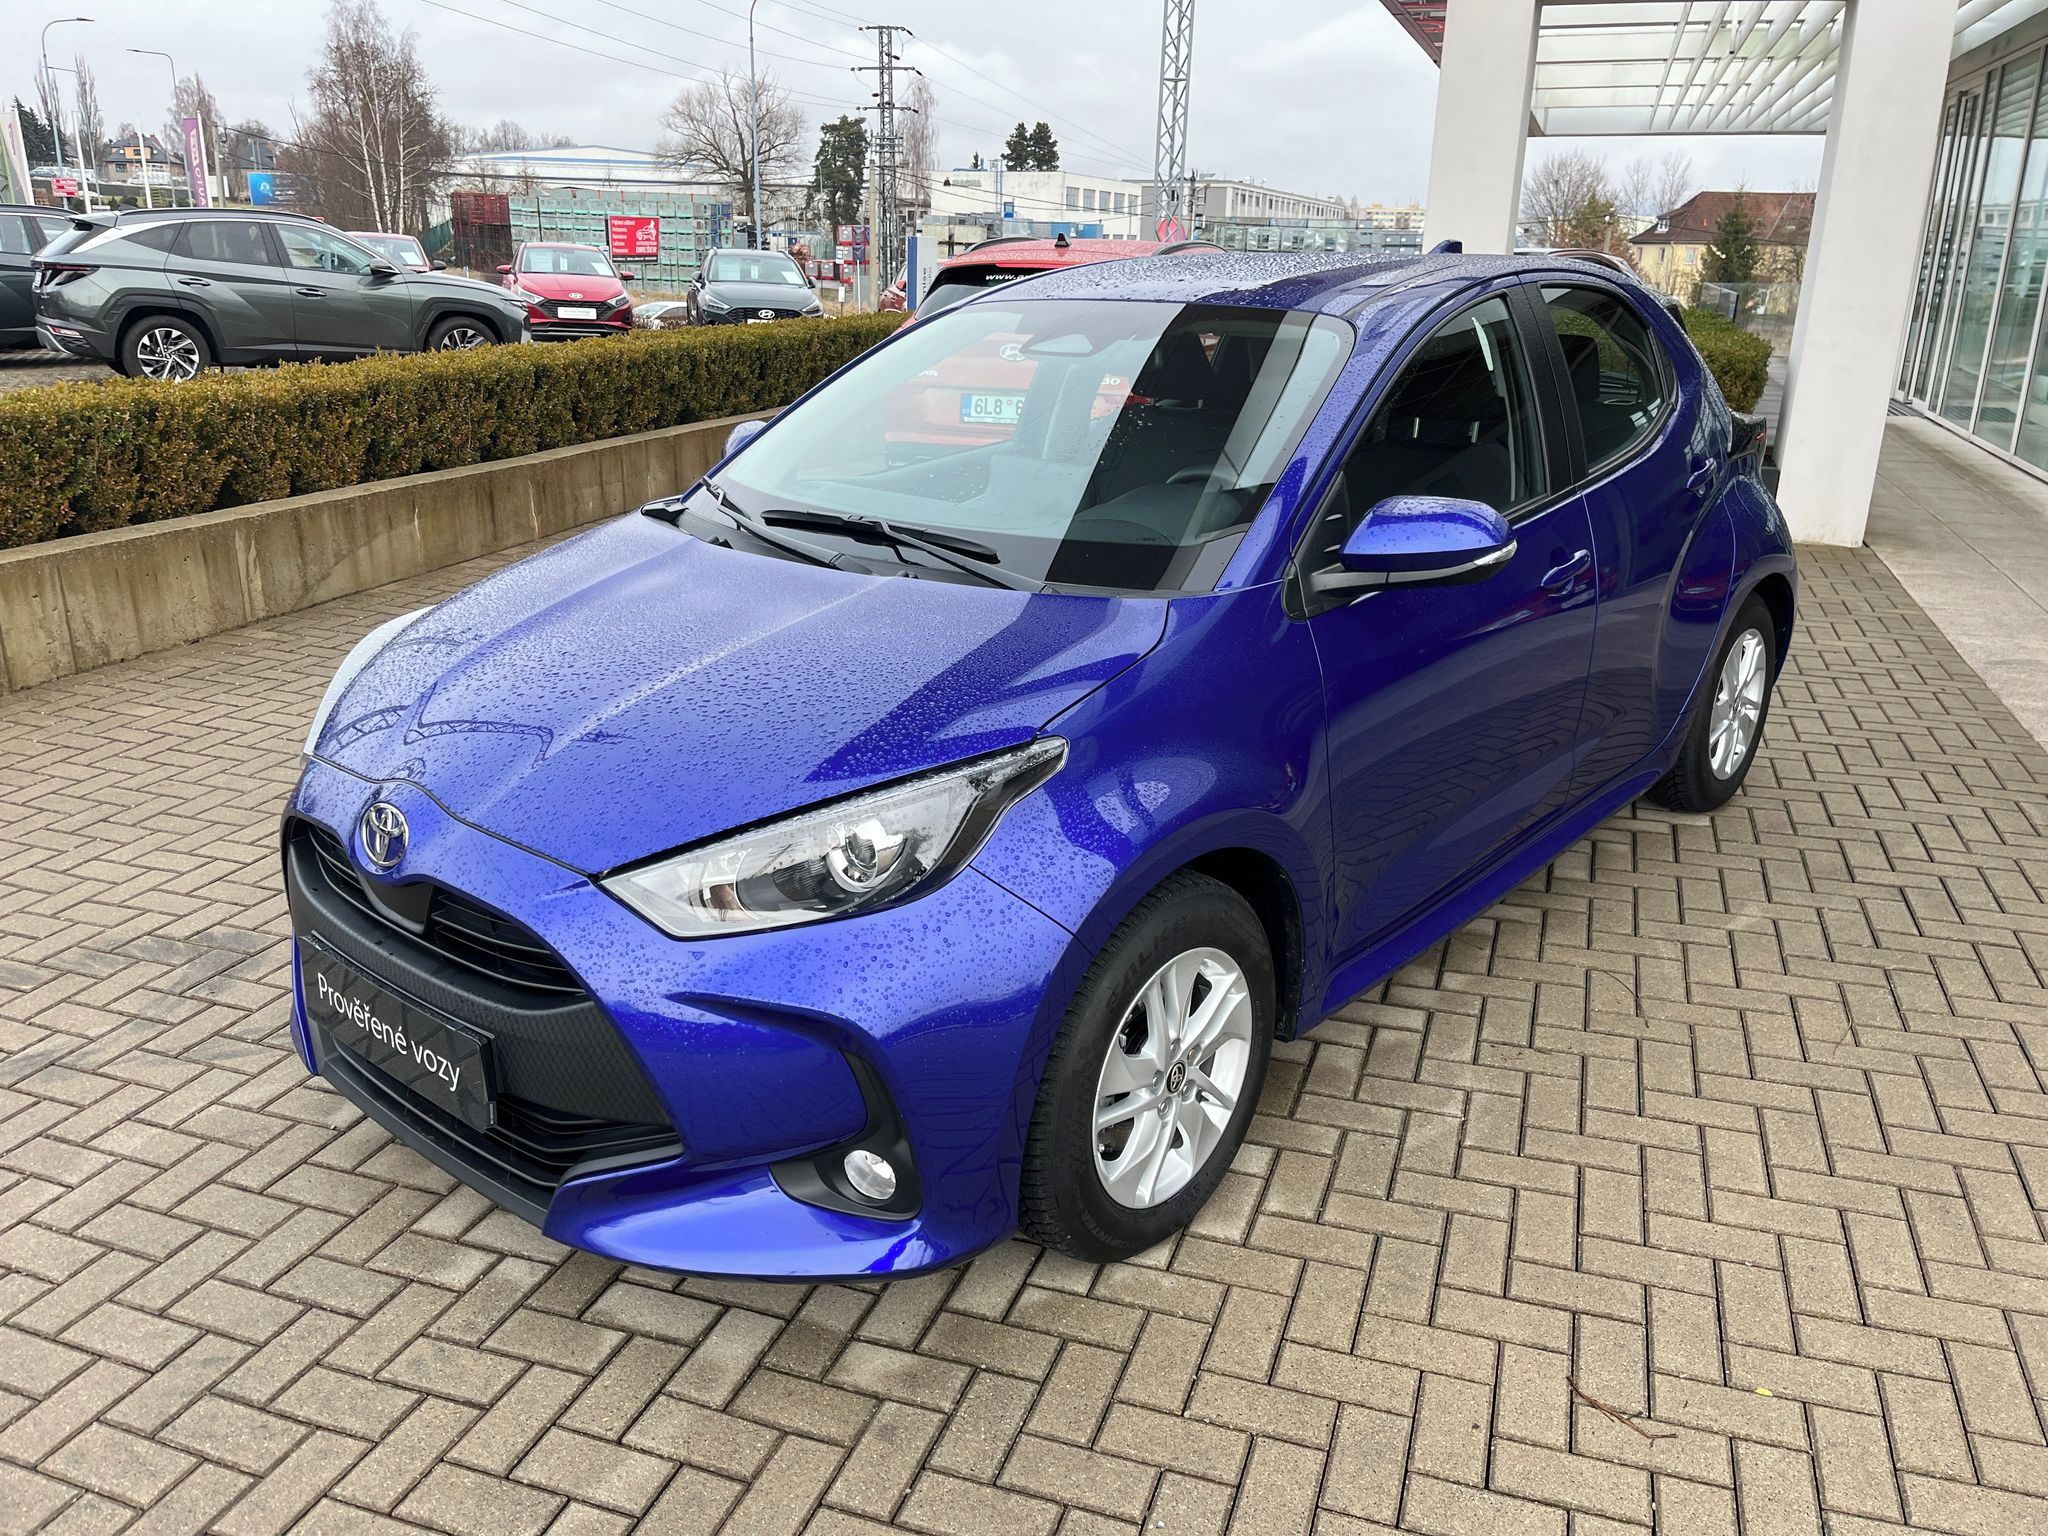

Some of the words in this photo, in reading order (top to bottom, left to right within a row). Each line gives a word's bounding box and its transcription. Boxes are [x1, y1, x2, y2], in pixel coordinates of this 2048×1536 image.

[974, 397, 1003, 416] 6L8
[317, 972, 408, 1056] Prověřené
[411, 1040, 461, 1092] vozy
